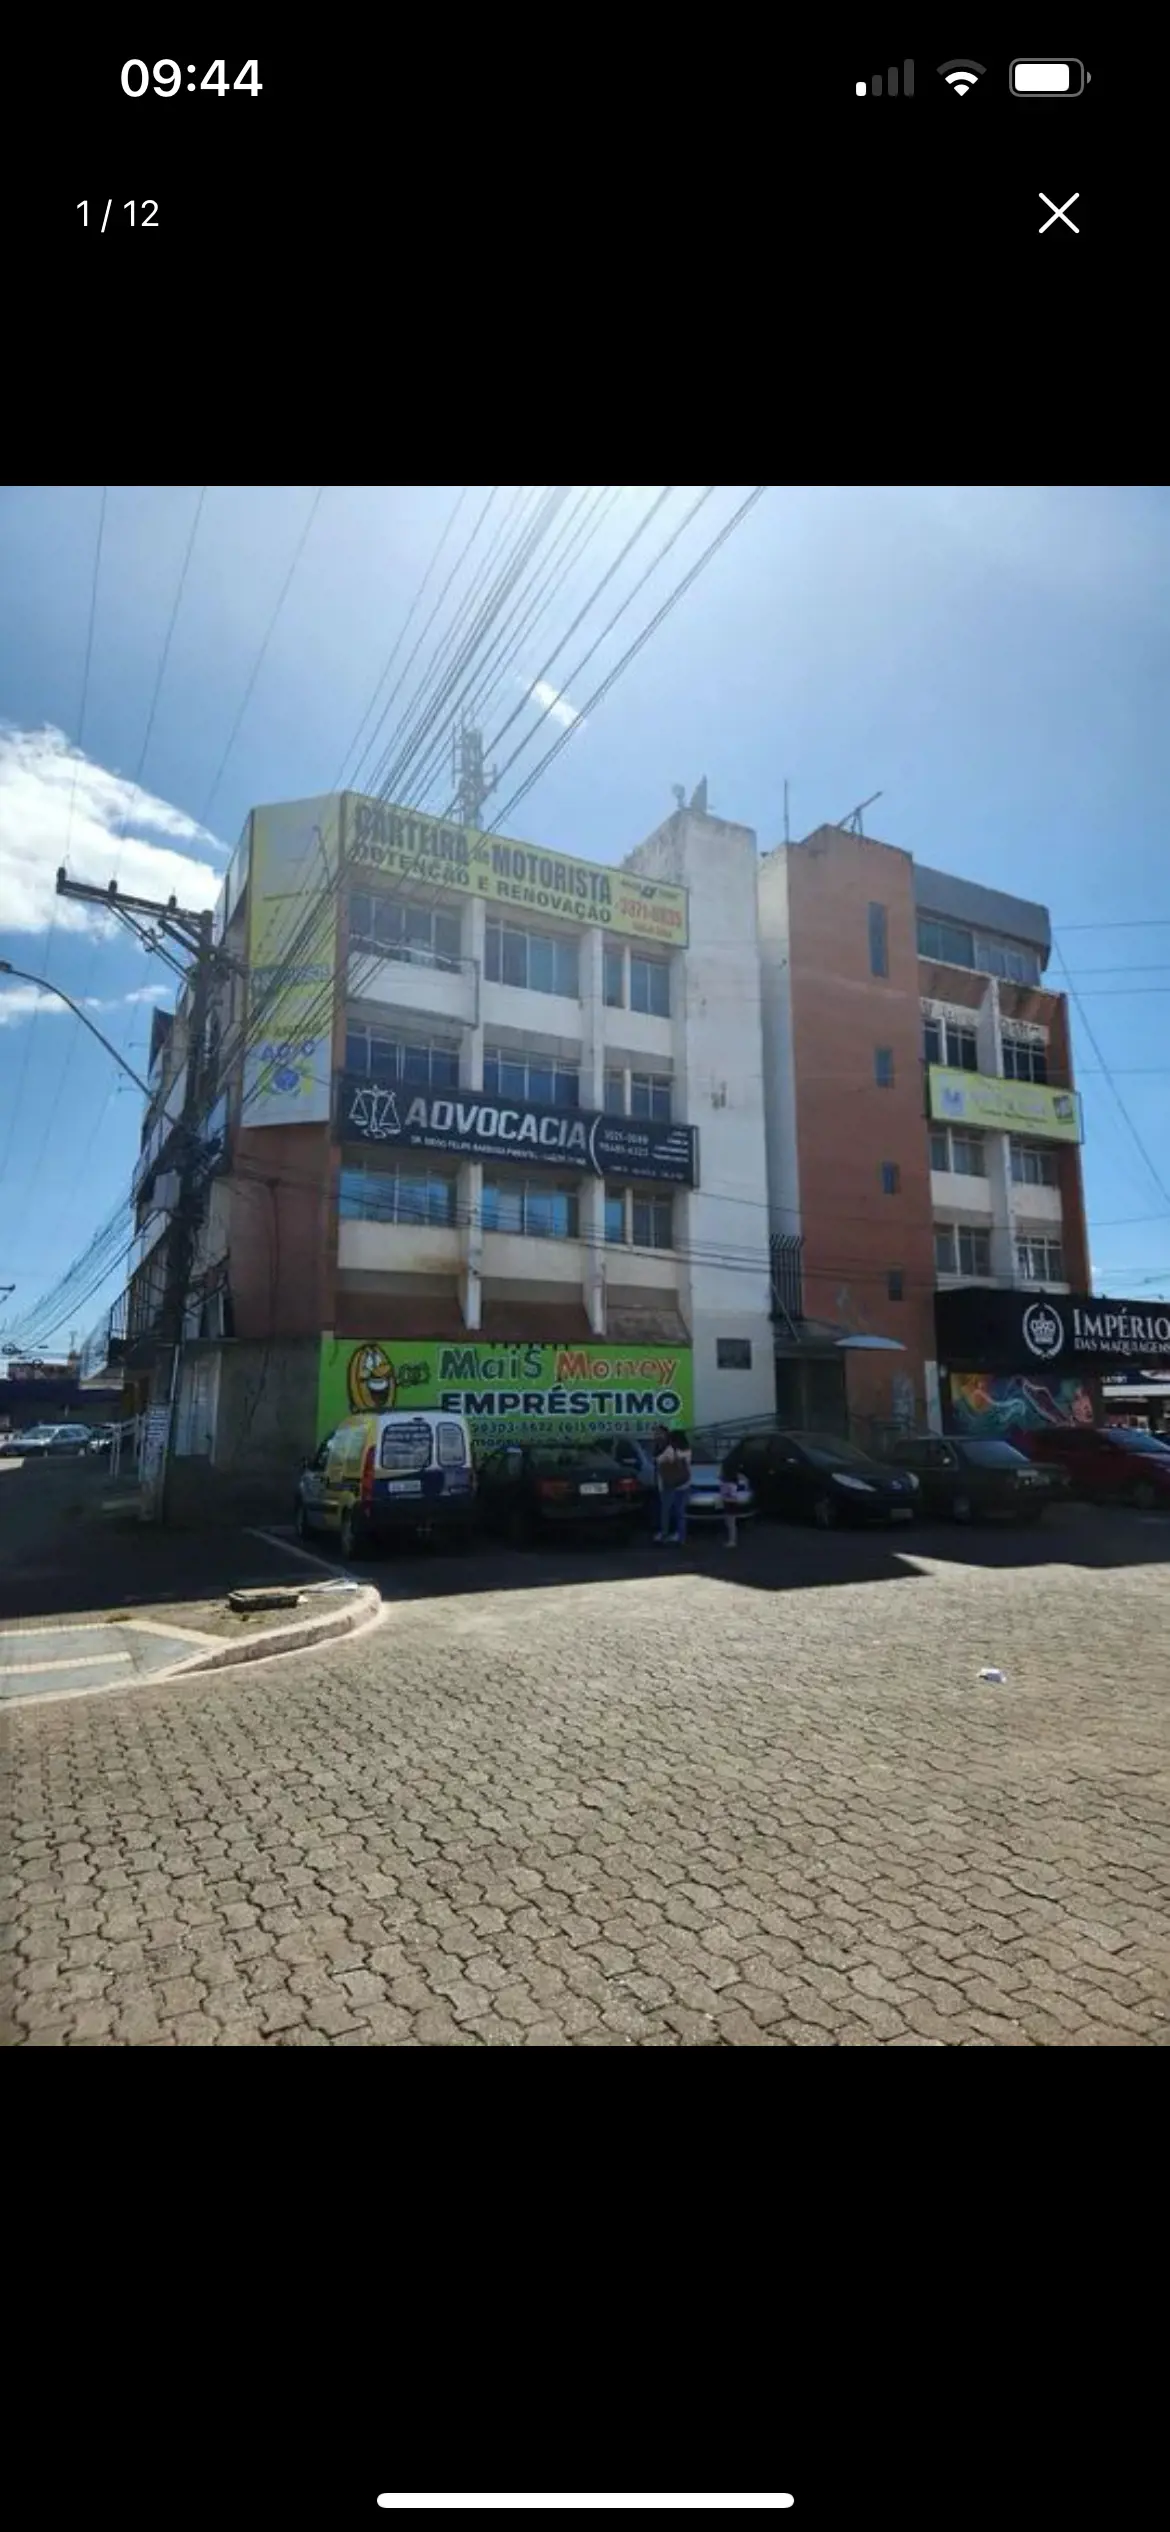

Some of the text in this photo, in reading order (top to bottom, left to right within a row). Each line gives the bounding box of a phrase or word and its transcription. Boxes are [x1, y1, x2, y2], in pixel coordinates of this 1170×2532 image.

[492, 844, 612, 905] MOTORISTA
[478, 875, 490, 891] E
[497, 880, 612, 923] RENOVAÇÃO
[404, 1098, 587, 1149] ADVOCACIA
[1073, 1306, 1170, 1341] IMPÉRIO
[1074, 1337, 1098, 1351] DAS
[556, 1349, 678, 1387] Money
[440, 1384, 682, 1415] EMPRÉSTIMO
